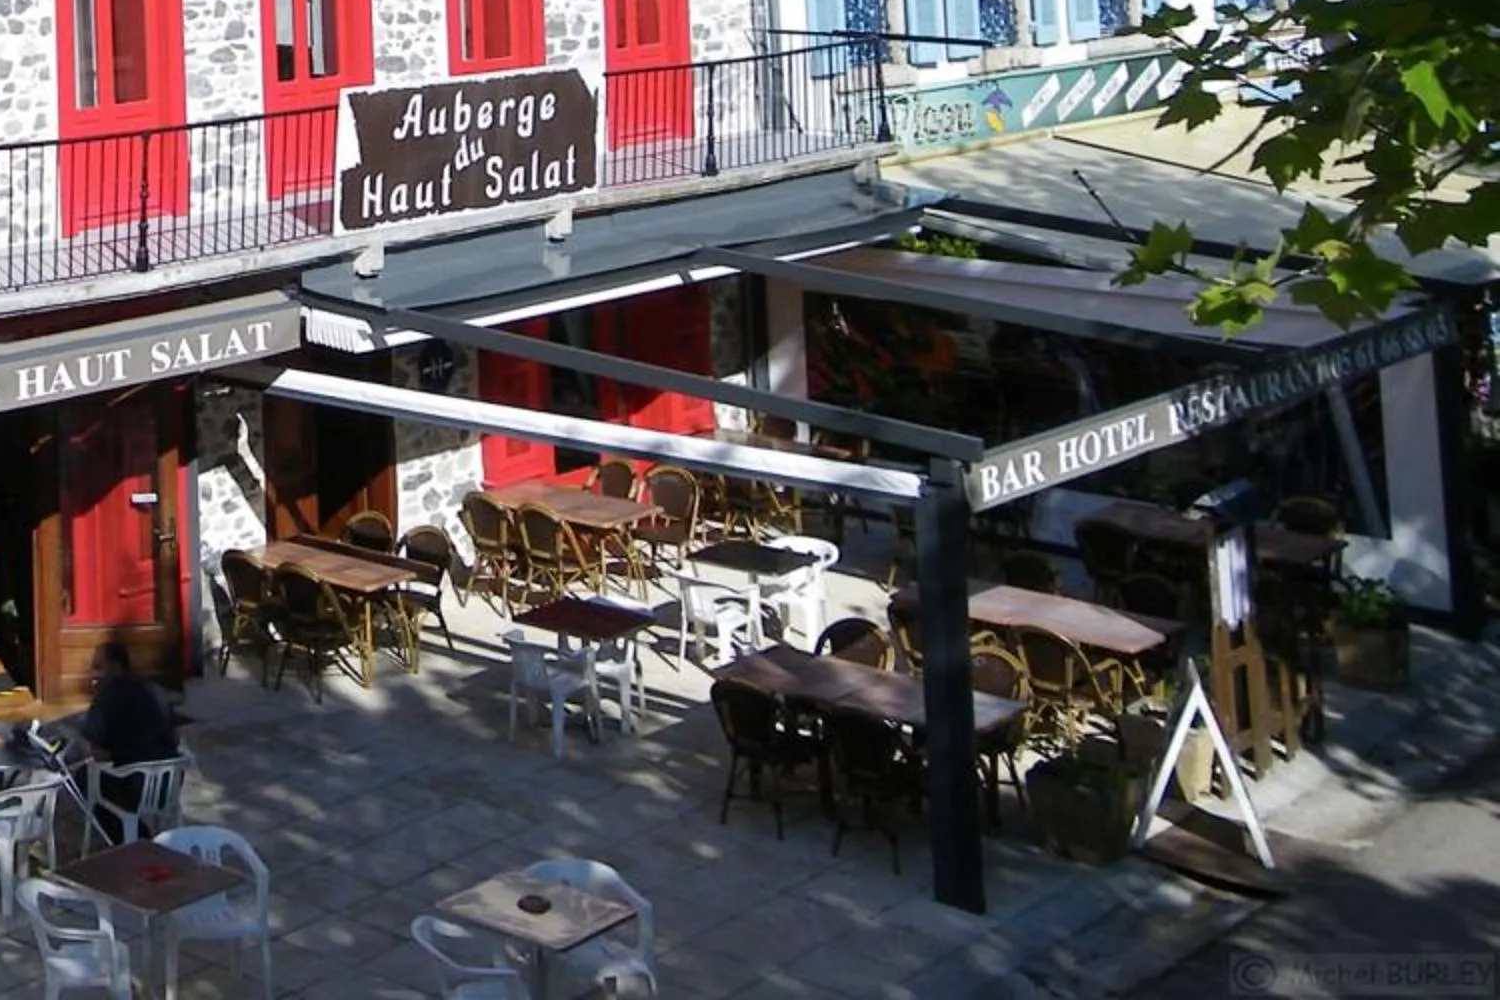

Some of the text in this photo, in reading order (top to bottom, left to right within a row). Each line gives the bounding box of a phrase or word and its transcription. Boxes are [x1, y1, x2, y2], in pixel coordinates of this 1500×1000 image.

[393, 90, 556, 140] Auberge
[362, 144, 576, 219] Haut Salat
[455, 135, 485, 171] du
[16, 348, 131, 401] HAUT
[151, 321, 272, 374] SALAT
[980, 449, 1045, 502] BAR
[1059, 413, 1155, 473] HOTEL
